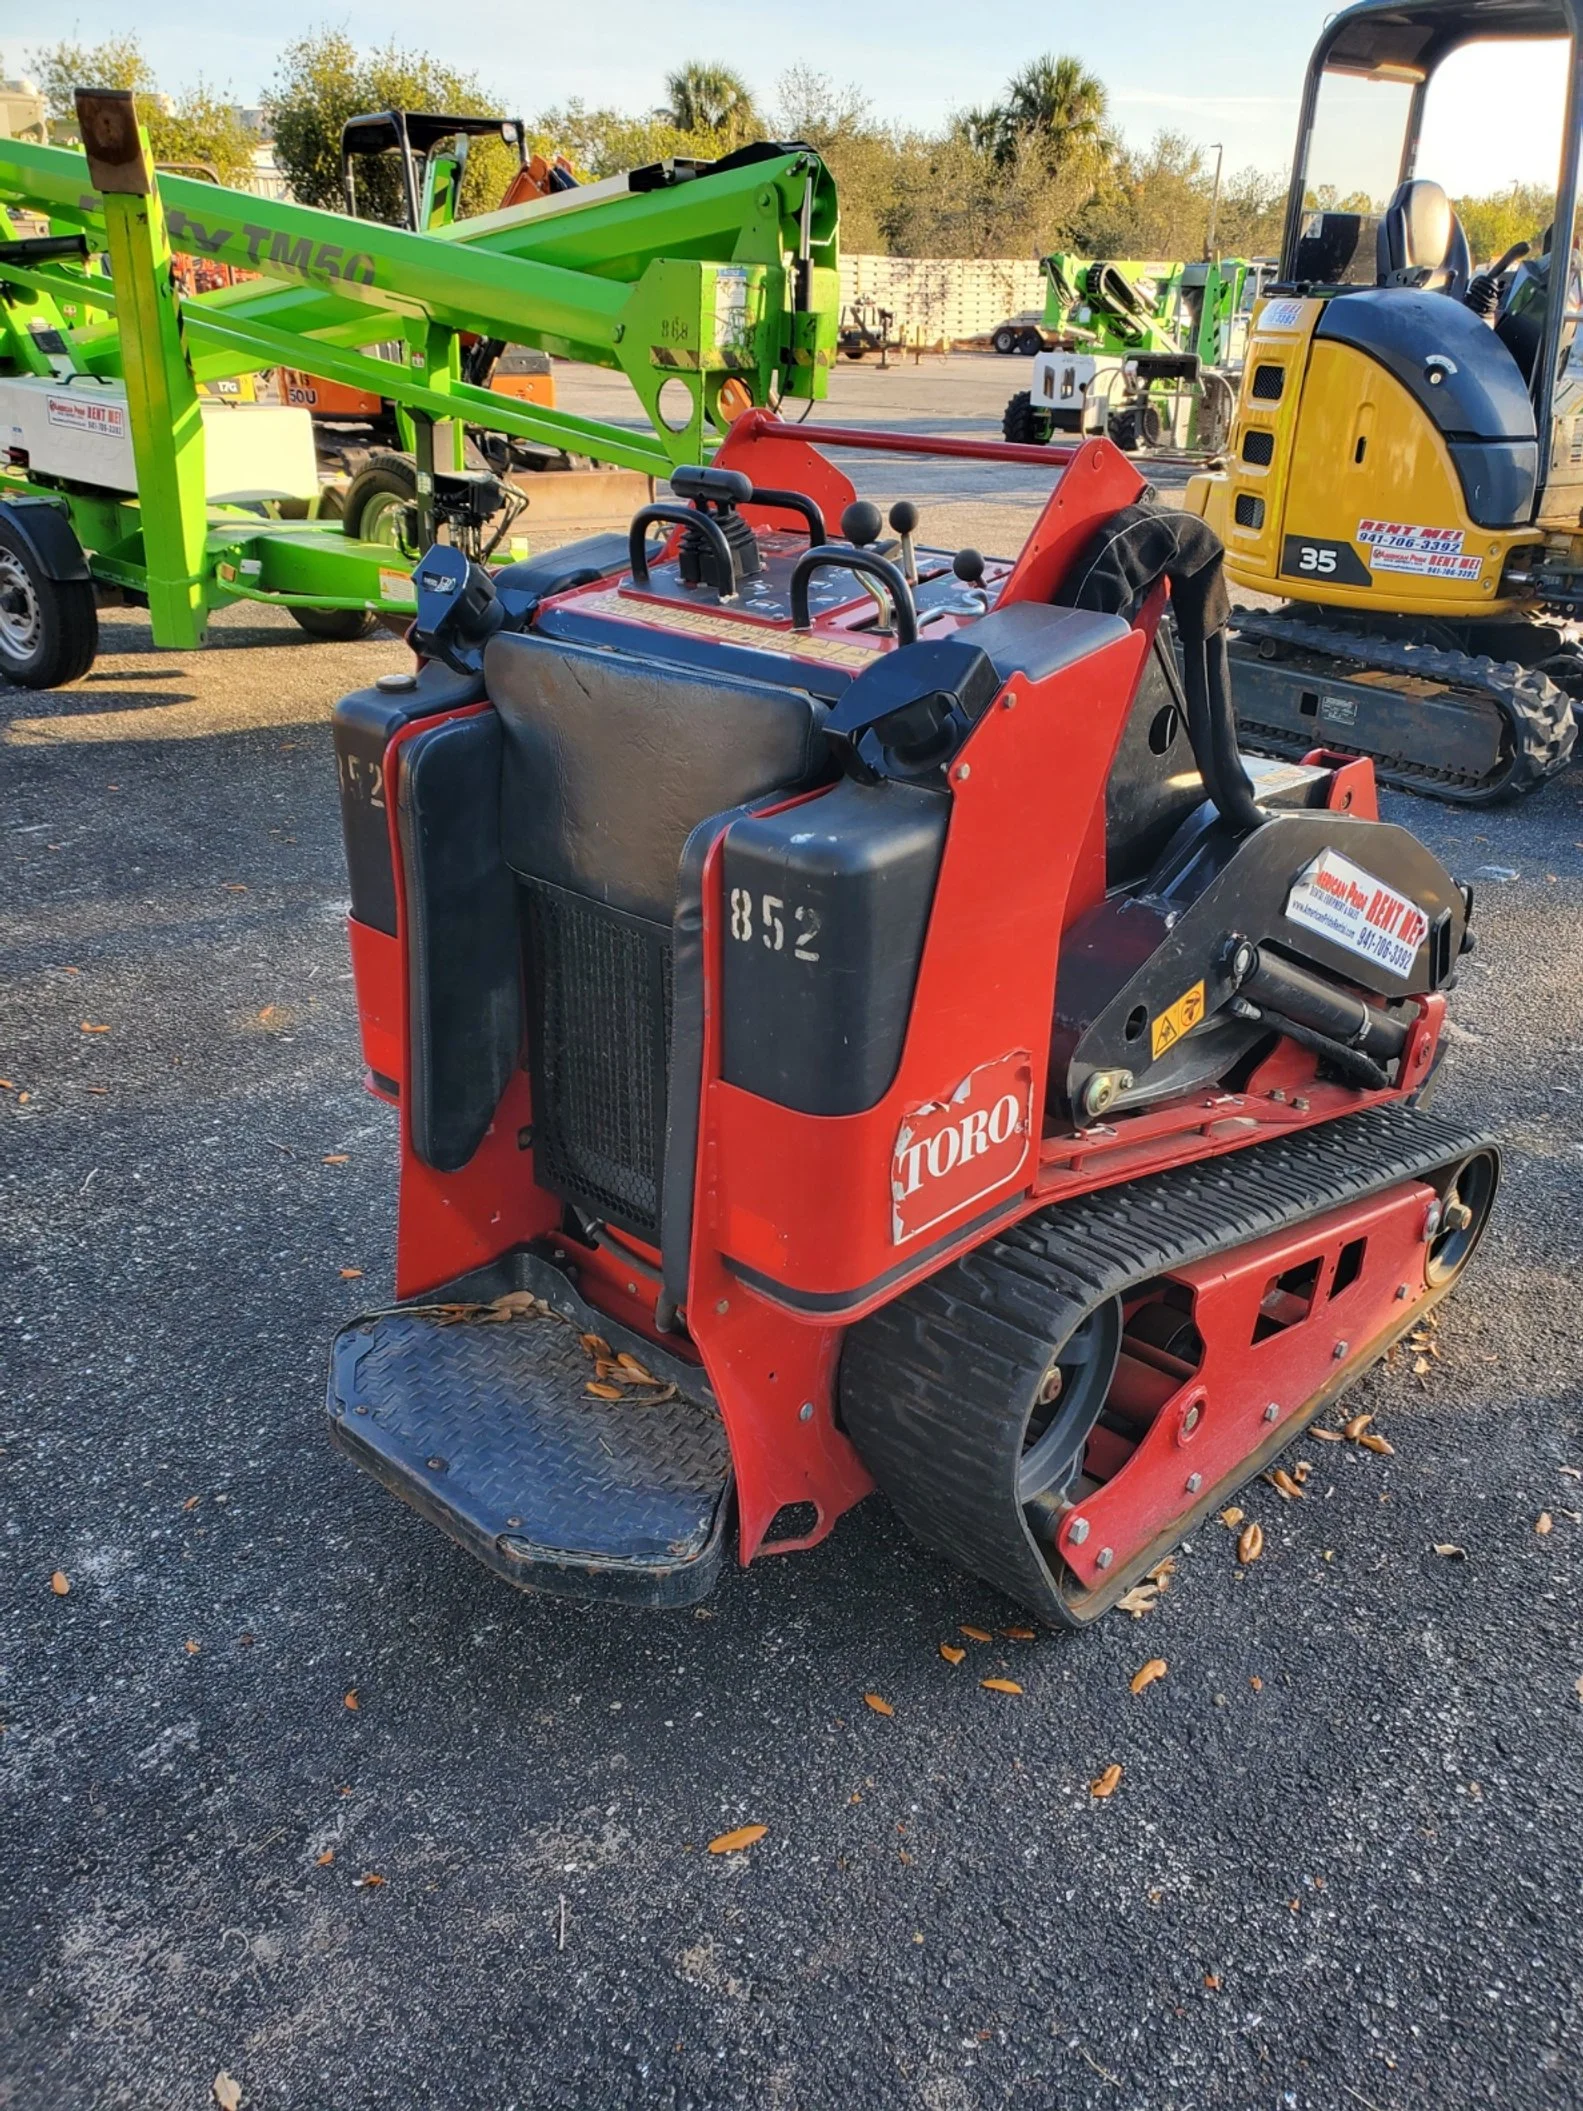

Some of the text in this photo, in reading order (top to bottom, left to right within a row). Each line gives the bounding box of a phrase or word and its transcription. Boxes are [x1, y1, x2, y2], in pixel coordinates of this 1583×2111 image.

[242, 224, 376, 291] TM50
[288, 388, 317, 405] 50U
[1359, 532, 1460, 553] 941-706-3392
[1360, 520, 1464, 541] RENT ME!
[1299, 546, 1337, 574] 35
[1428, 555, 1458, 567] RENT
[730, 887, 822, 962] 852
[1365, 889, 1405, 934] RENT
[1356, 926, 1413, 970] 941-706-3392
[898, 1094, 1020, 1197] TORO
